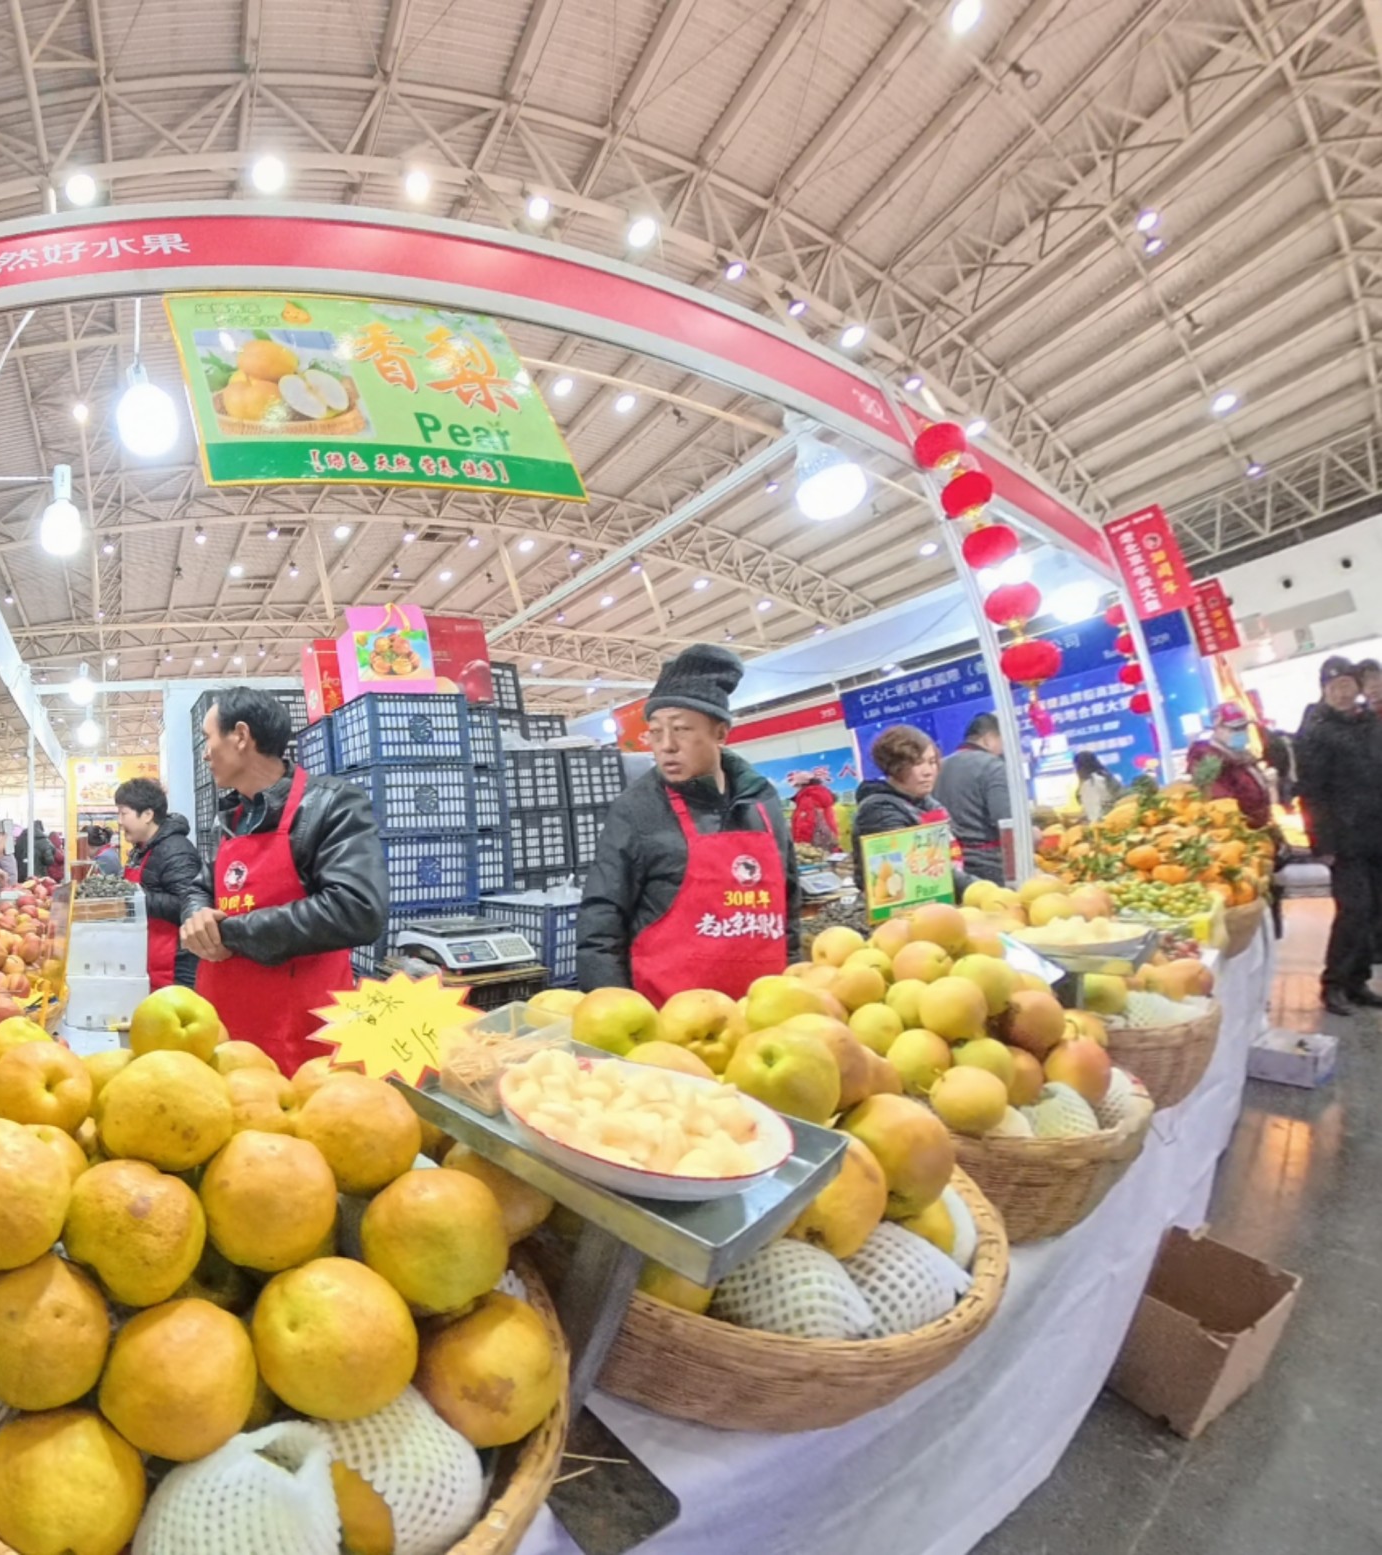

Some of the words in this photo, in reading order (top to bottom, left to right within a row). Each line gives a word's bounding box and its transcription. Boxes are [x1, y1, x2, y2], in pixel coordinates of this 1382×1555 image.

[353, 320, 521, 416] 香梨
[414, 411, 510, 452] Pear
[722, 890, 771, 909] 30周年
